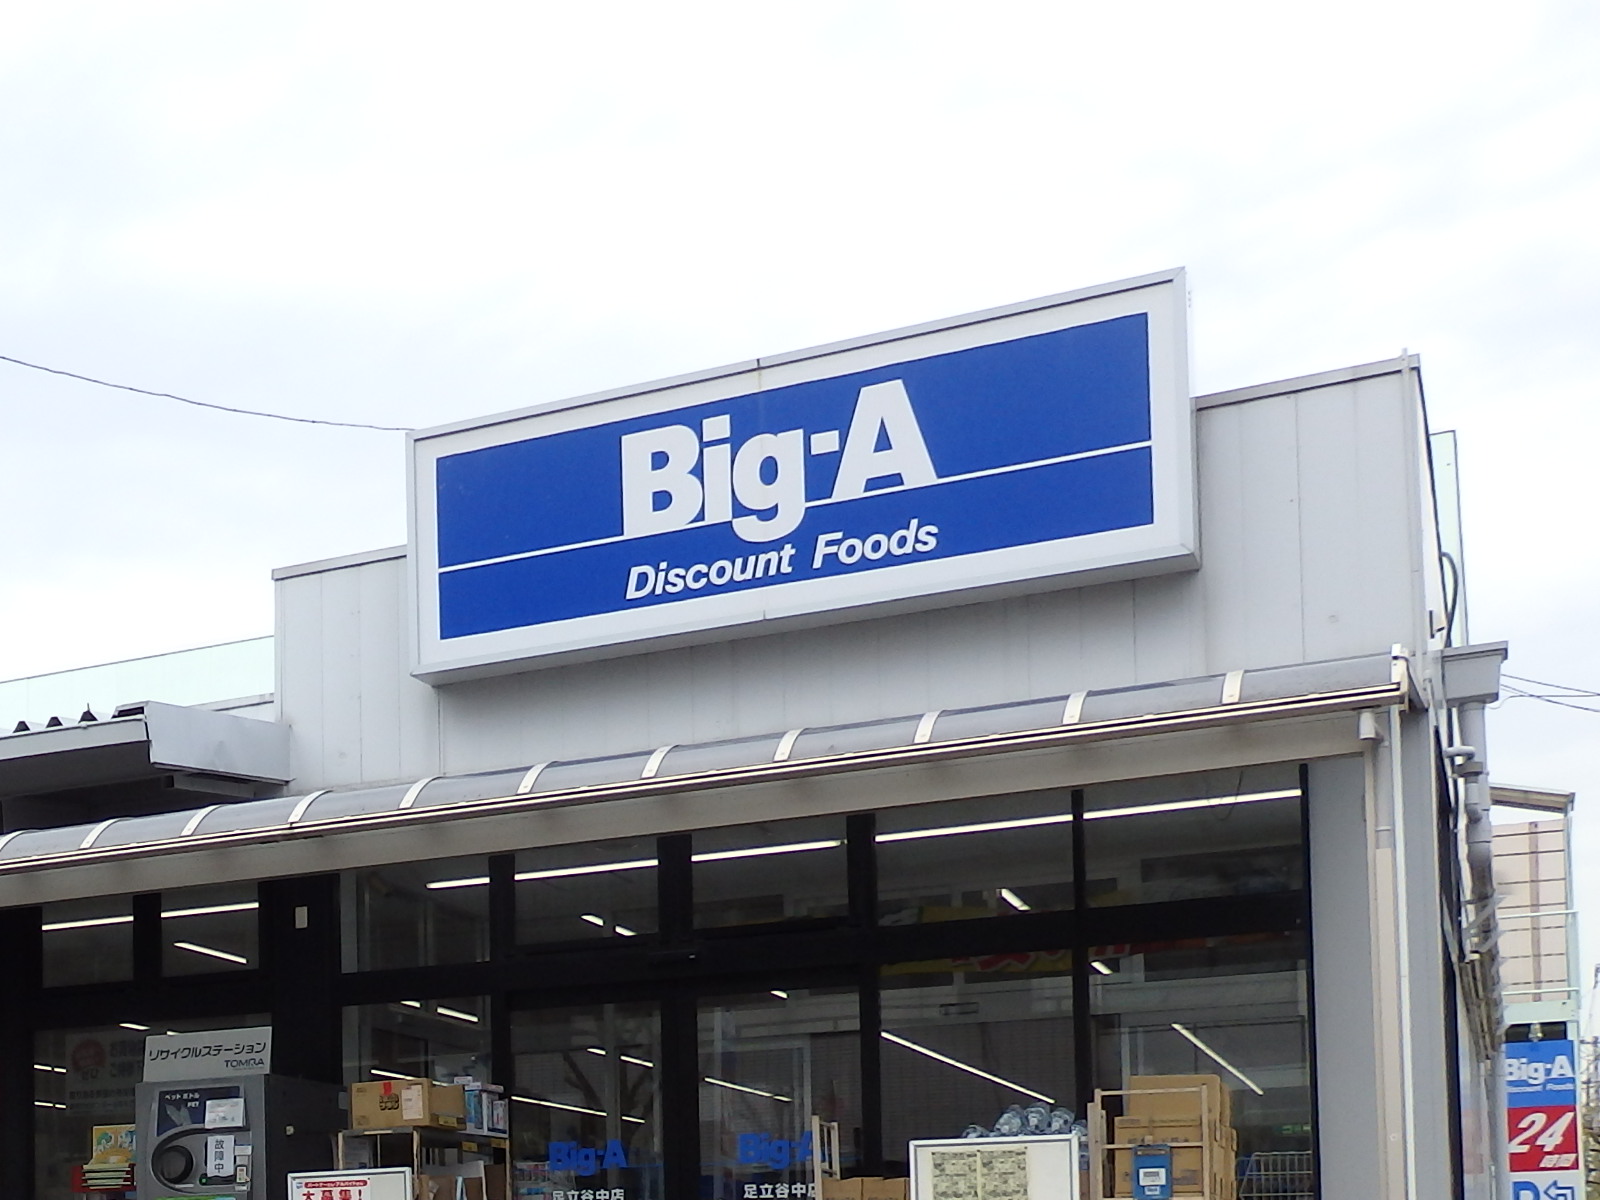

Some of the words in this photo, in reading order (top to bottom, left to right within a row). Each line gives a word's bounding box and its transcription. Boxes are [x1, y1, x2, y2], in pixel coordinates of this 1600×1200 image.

[620, 378, 938, 543] Big-A
[625, 544, 796, 601] Discount
[811, 518, 939, 571] Foods
[148, 1041, 268, 1062] リサイクルステーション
[224, 1058, 265, 1068] TOMRA
[1503, 1054, 1575, 1085] Big-A
[1508, 1112, 1576, 1154] 24
